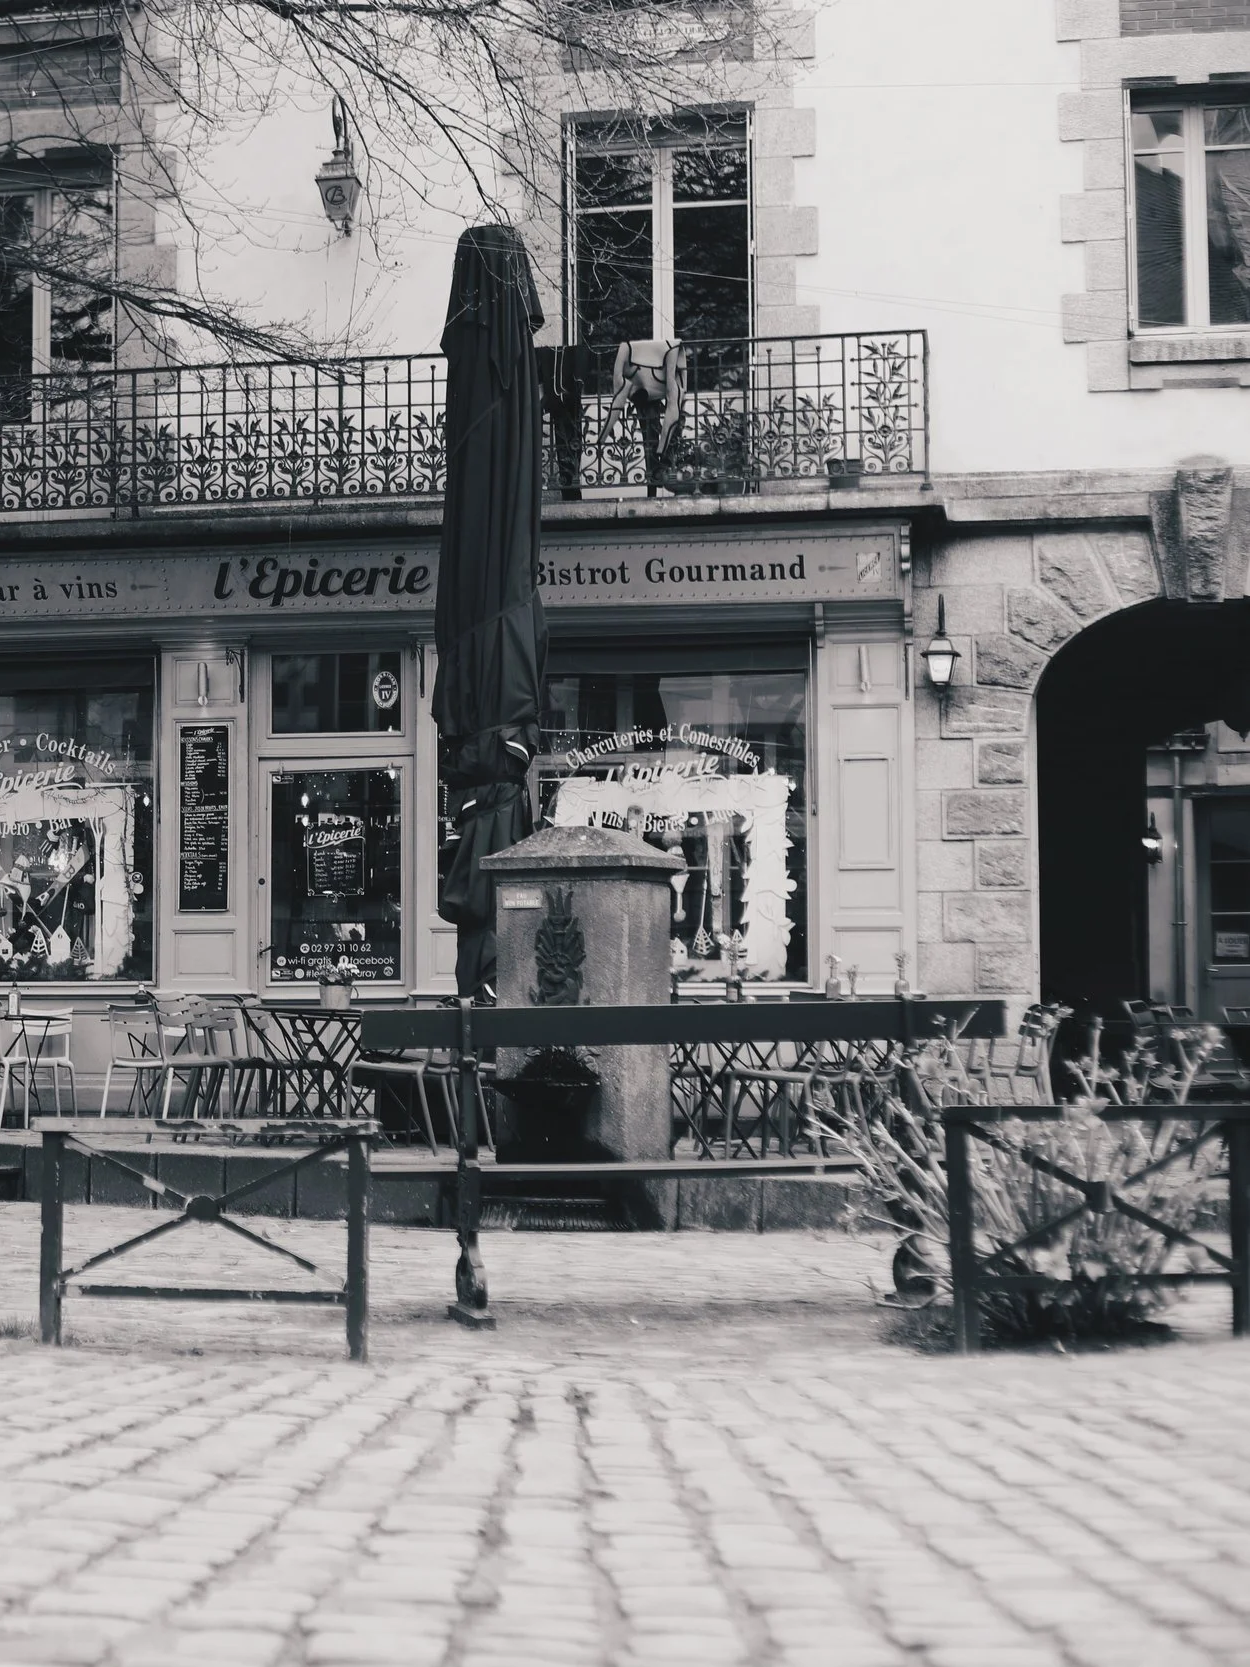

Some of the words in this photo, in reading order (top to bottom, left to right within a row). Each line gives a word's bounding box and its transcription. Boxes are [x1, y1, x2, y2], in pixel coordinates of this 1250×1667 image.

[213, 555, 433, 607] l'Epicerie
[536, 561, 630, 586] Bistrot
[645, 554, 807, 584] Gourmand
[33, 578, 48, 600] à
[59, 575, 118, 599] vins
[36, 732, 116, 775] Cocktails
[565, 726, 654, 769] Charcuteries
[659, 726, 674, 742] et
[680, 723, 760, 768] Comestibles
[309, 826, 362, 845] l'Epicerie
[287, 956, 306, 965] wi-fi
[311, 943, 322, 953] 02
[324, 943, 334, 953] 97
[337, 943, 346, 953] 31
[350, 943, 359, 953] 10
[360, 943, 371, 953] 62
[350, 955, 395, 965] facebook
